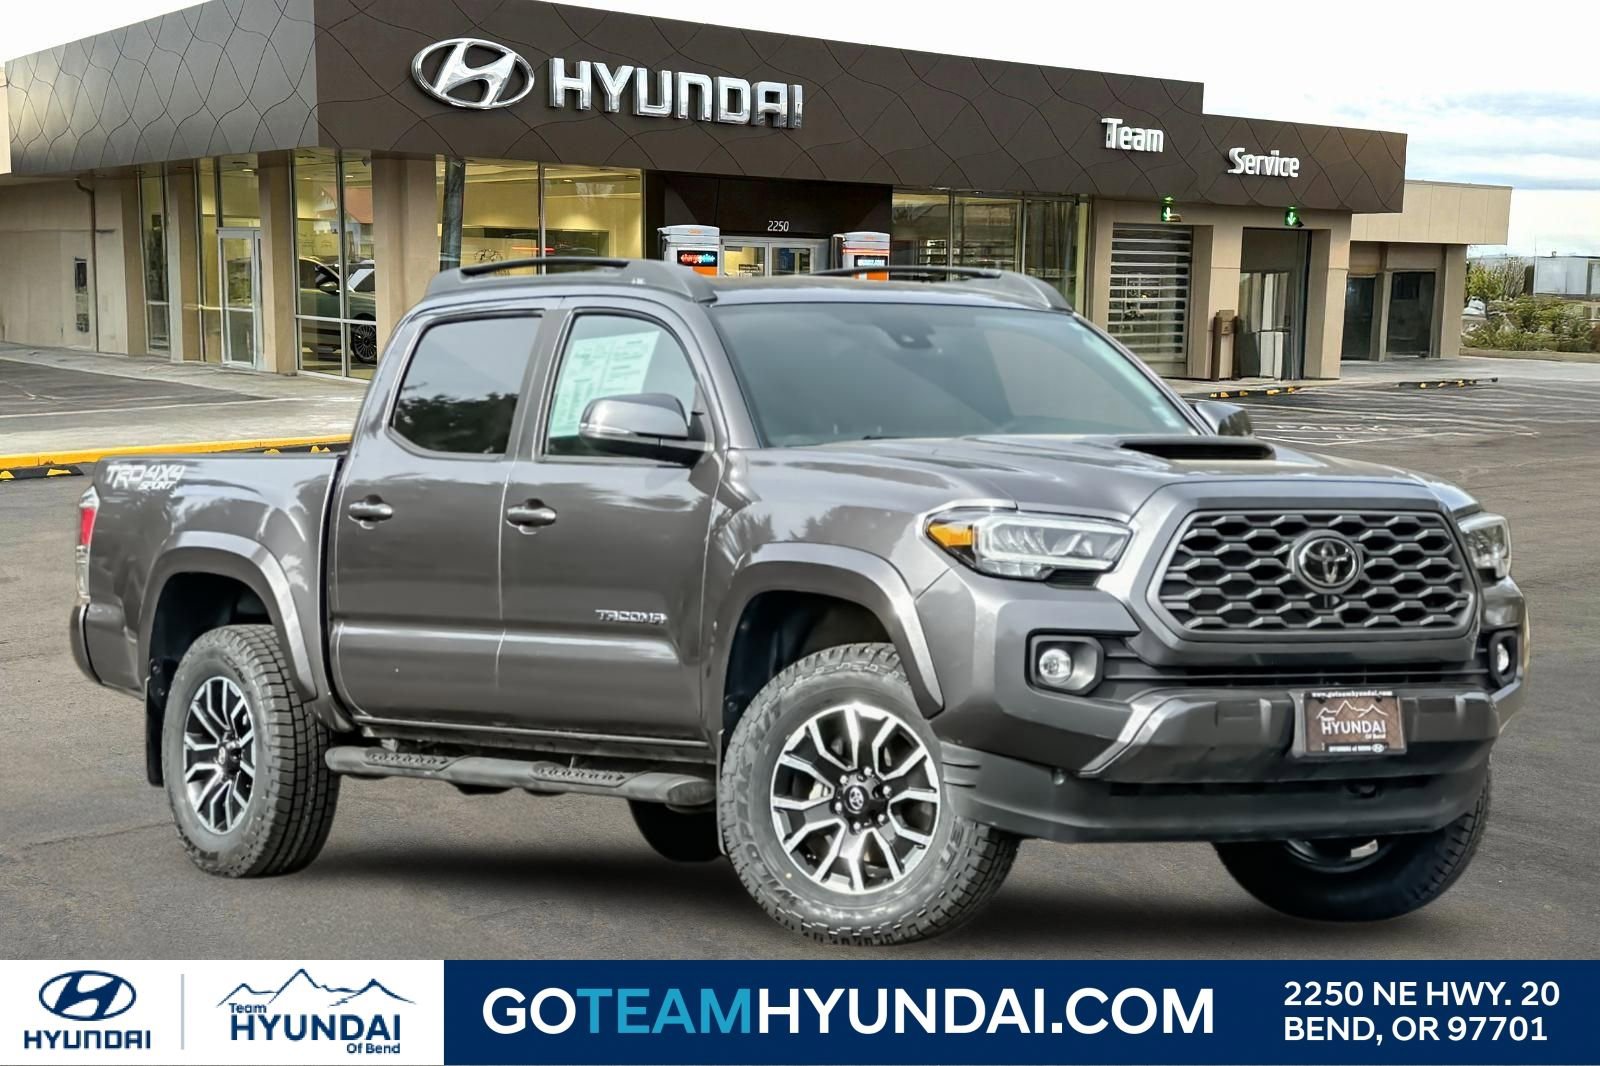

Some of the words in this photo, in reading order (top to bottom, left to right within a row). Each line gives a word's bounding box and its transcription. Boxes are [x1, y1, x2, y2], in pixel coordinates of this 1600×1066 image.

[548, 57, 804, 129] HYUNDAI
[1101, 117, 1164, 153] Team
[1227, 147, 1300, 178] Service
[767, 220, 790, 232] 2250
[138, 480, 178, 490] SPORT
[594, 609, 668, 624] TACOMA
[1321, 720, 1387, 735] HYUNDAI
